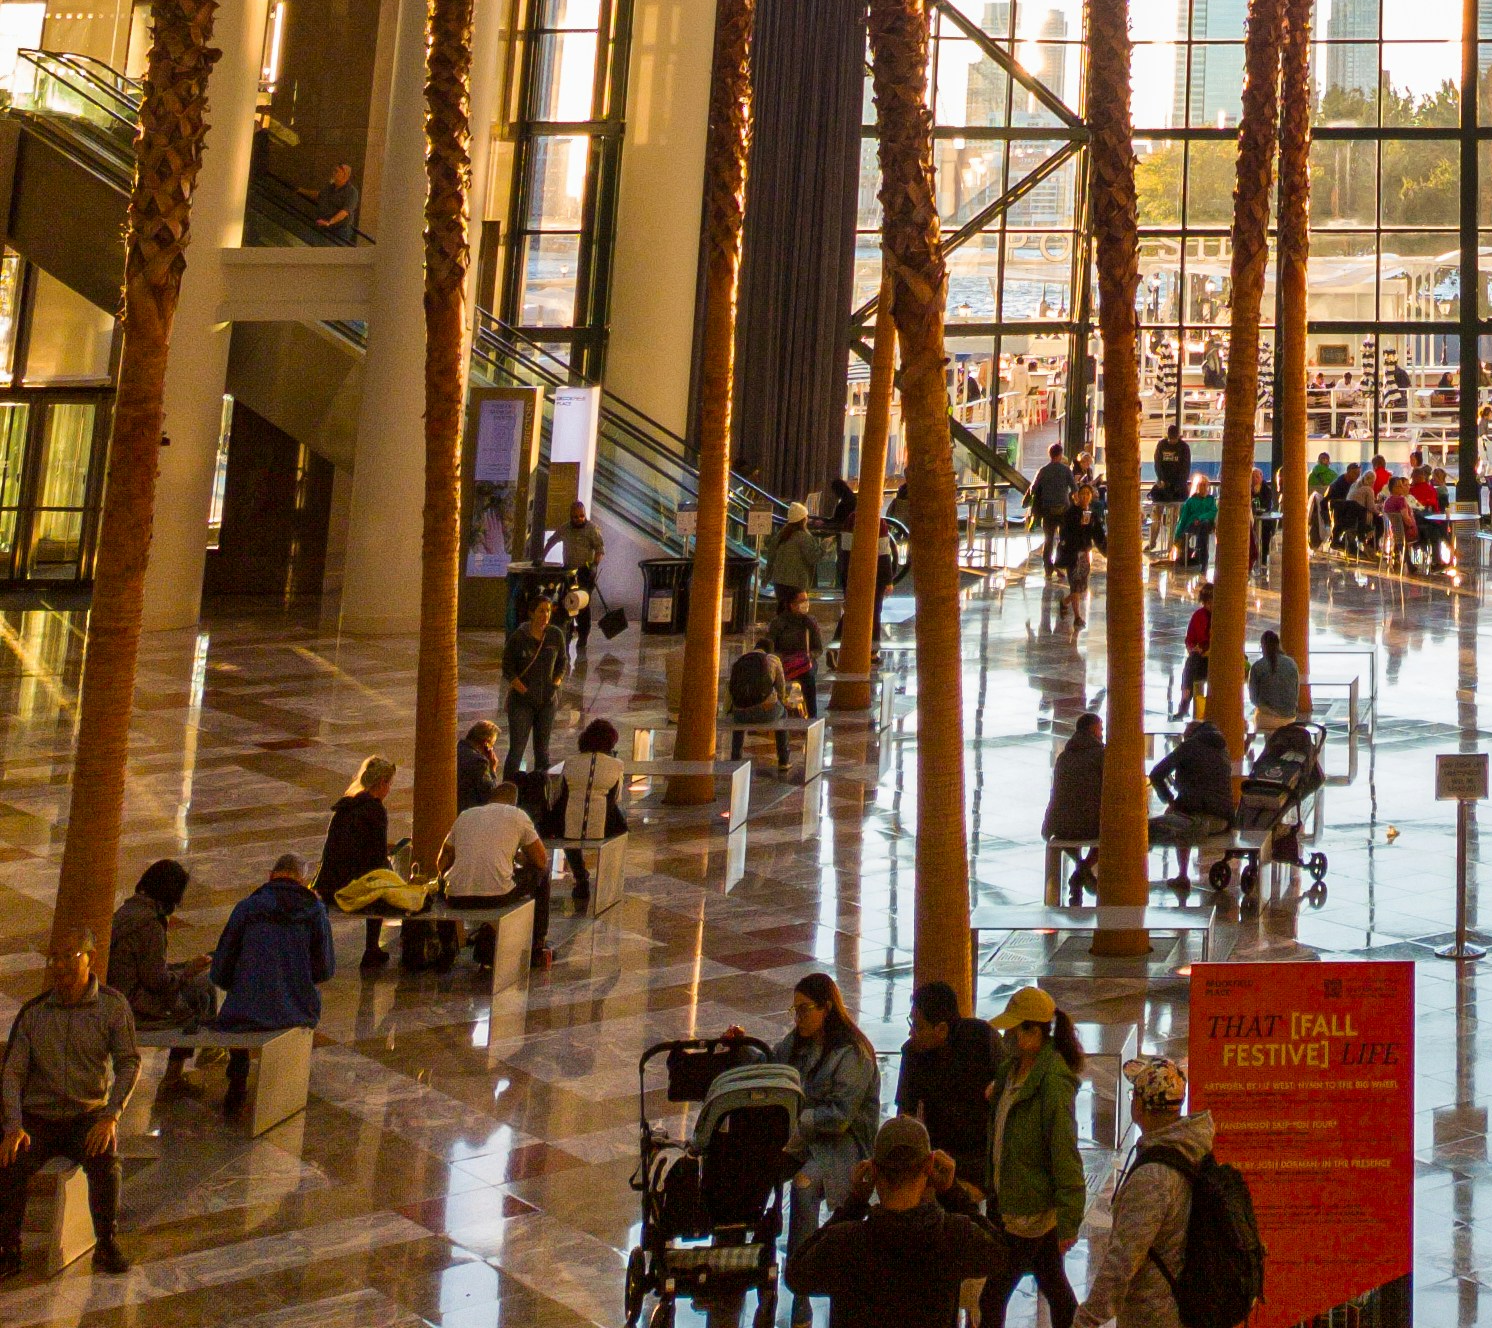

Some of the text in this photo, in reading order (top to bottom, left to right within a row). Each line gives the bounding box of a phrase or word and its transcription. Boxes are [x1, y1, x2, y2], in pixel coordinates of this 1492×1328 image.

[1208, 1011, 1358, 1040] THAT [FALL
[1223, 1040, 1401, 1069] FESTIVE] LIFE
[1204, 1082, 1244, 1091] ARTWORK
